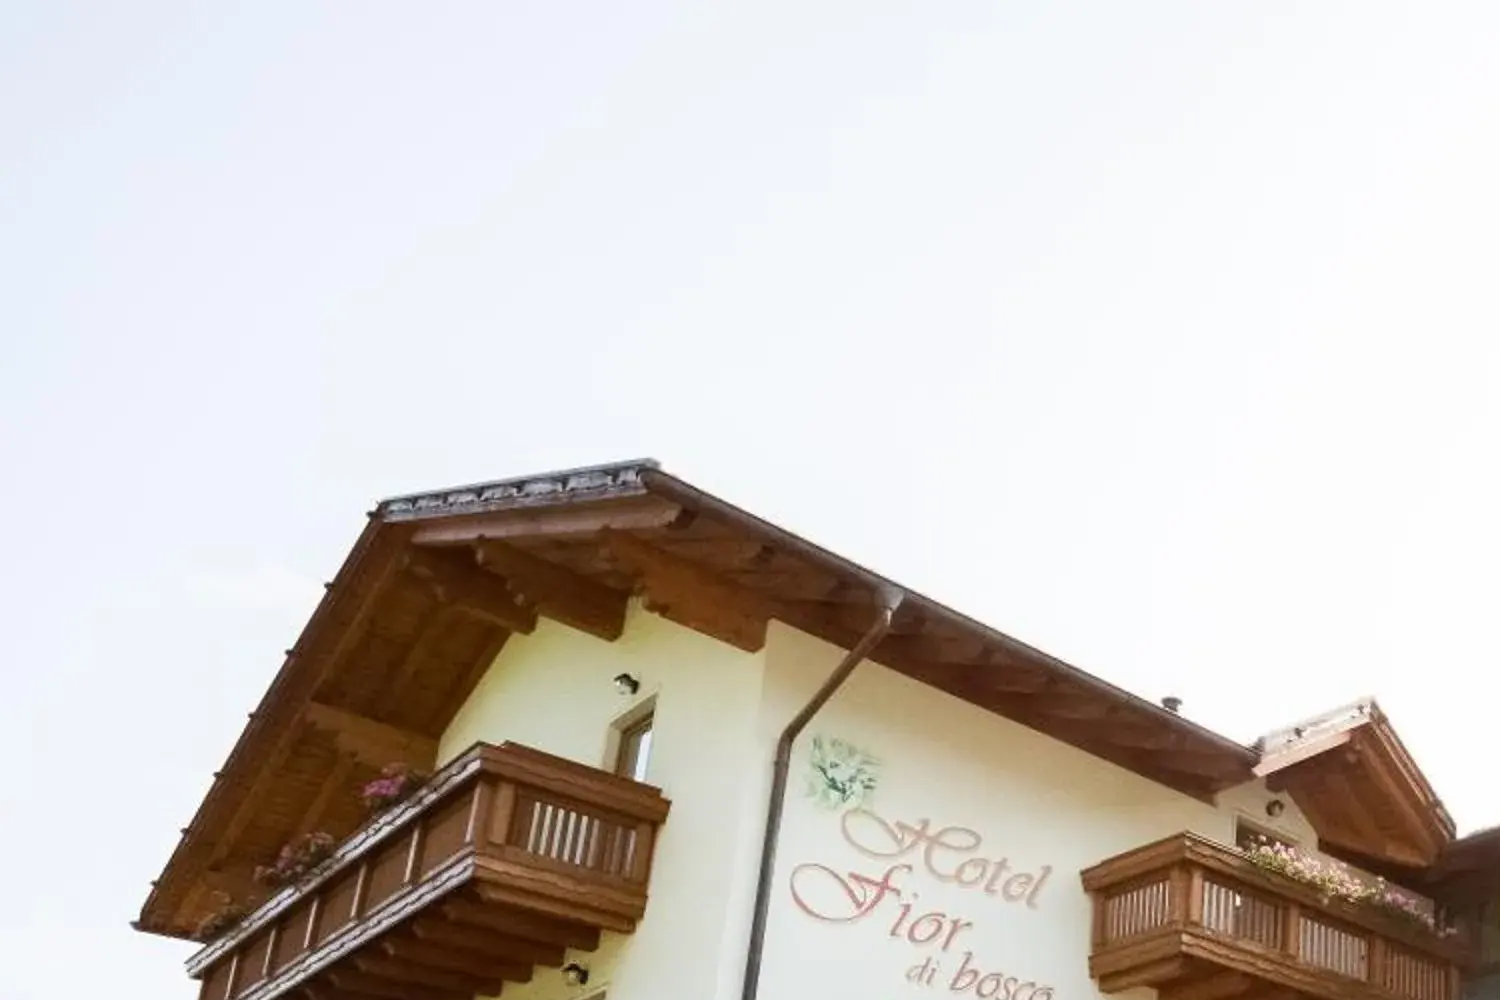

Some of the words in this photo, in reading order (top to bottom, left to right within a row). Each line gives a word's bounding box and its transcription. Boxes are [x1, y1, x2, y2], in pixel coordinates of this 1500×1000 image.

[841, 808, 1053, 909] Hotel
[790, 863, 973, 951] Fior
[905, 956, 938, 985] di
